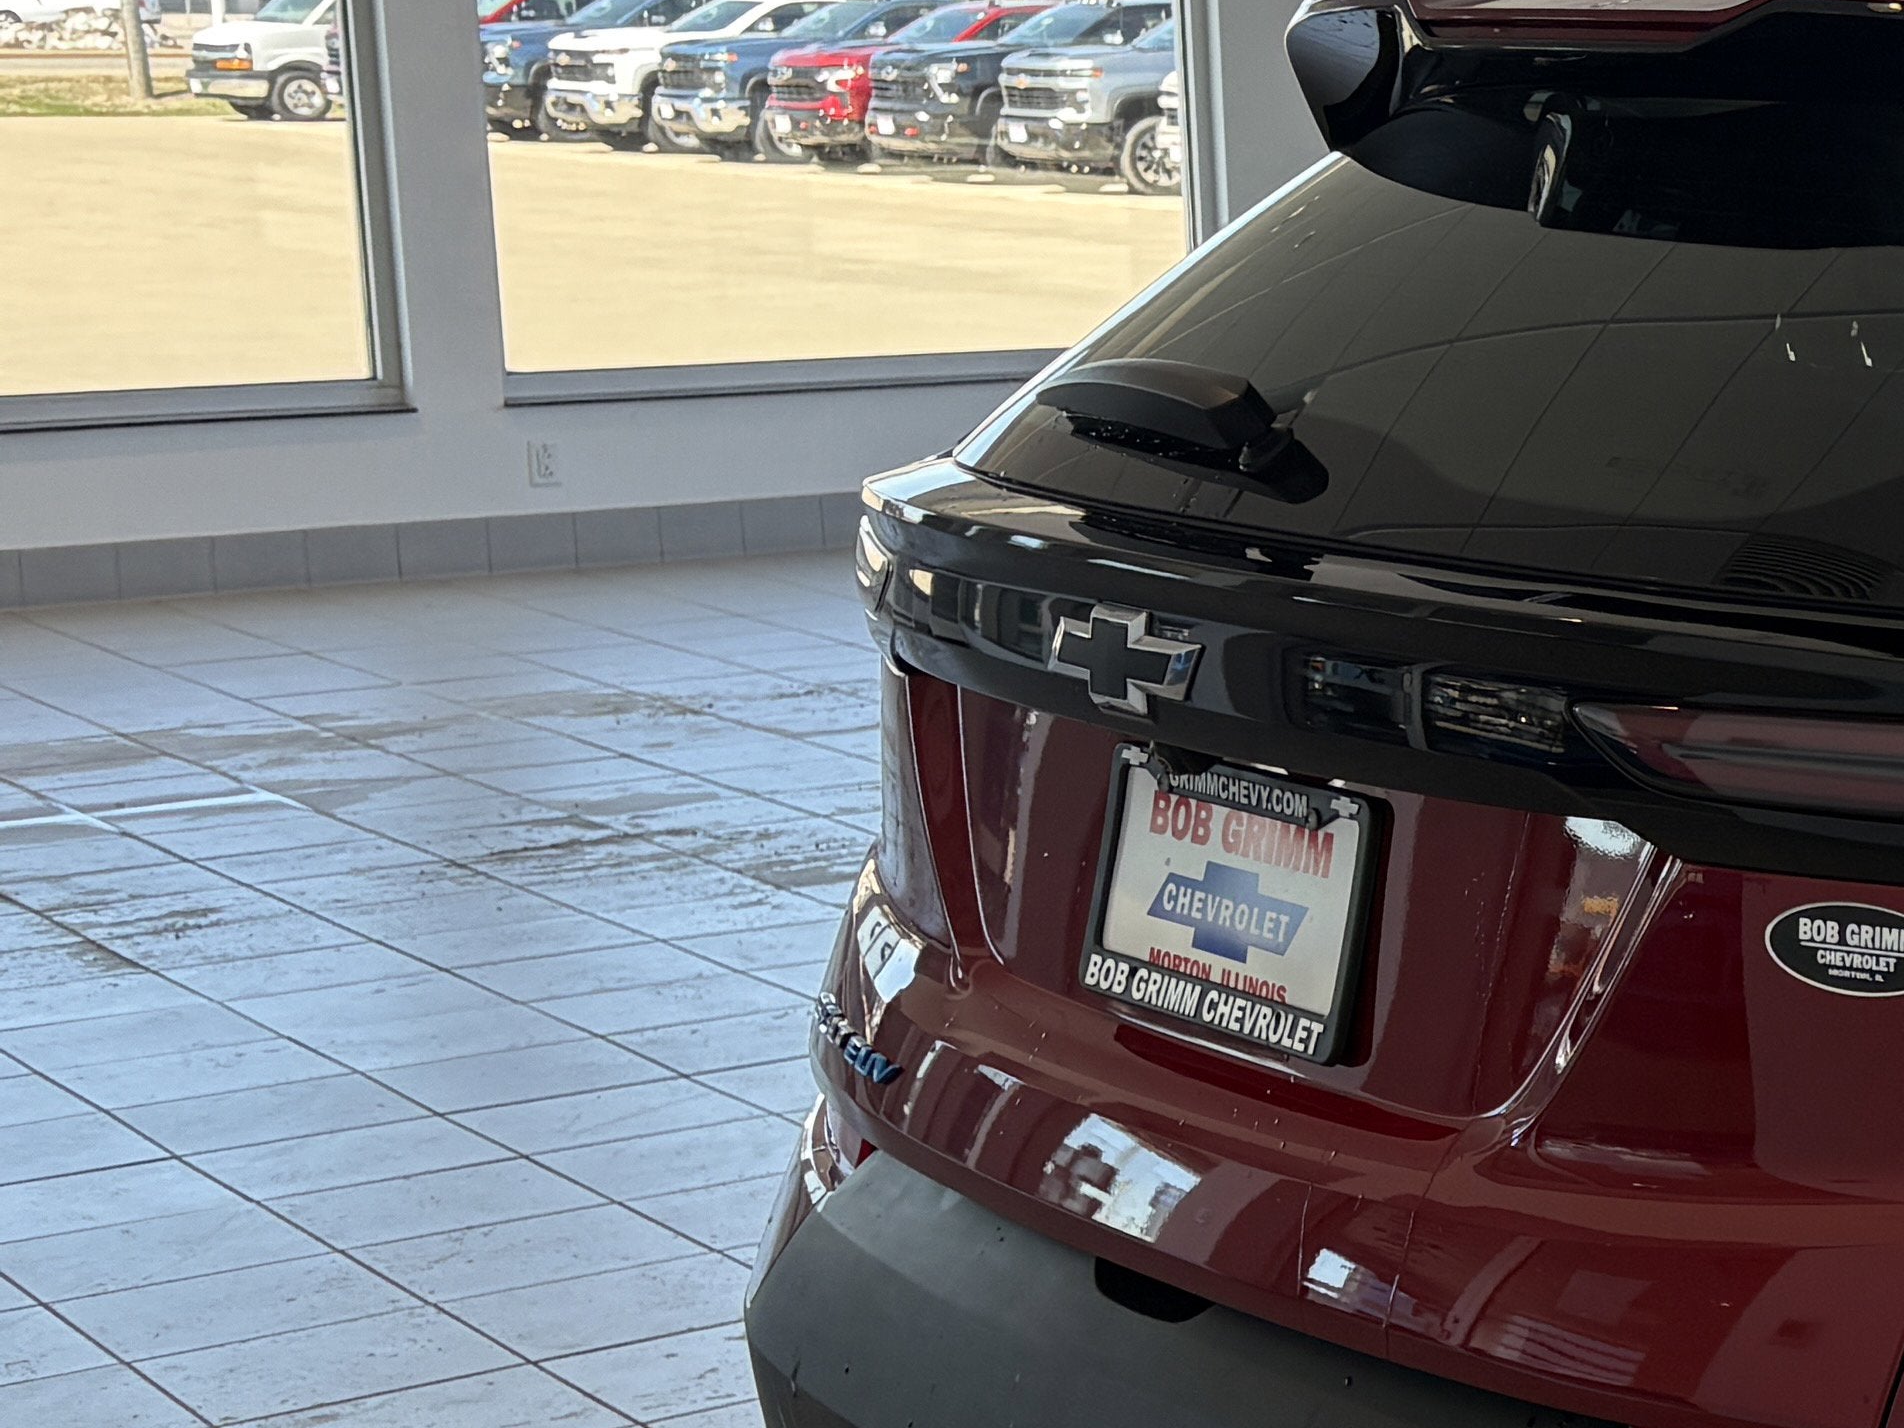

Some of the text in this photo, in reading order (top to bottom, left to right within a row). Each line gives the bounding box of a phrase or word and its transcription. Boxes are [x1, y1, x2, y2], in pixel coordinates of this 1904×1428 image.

[1169, 772, 1309, 819] GRIMMCHEVY.COM
[1149, 789, 1335, 879] BOB GRIMM
[1162, 882, 1291, 943] CHEVROLET
[1798, 917, 1840, 944] BOB
[1148, 946, 1288, 1005] MORTON ILLINOIS
[1816, 949, 1897, 972] CHEVROLET
[1084, 953, 1325, 1055] BOB GRIMM CHEVROLET
